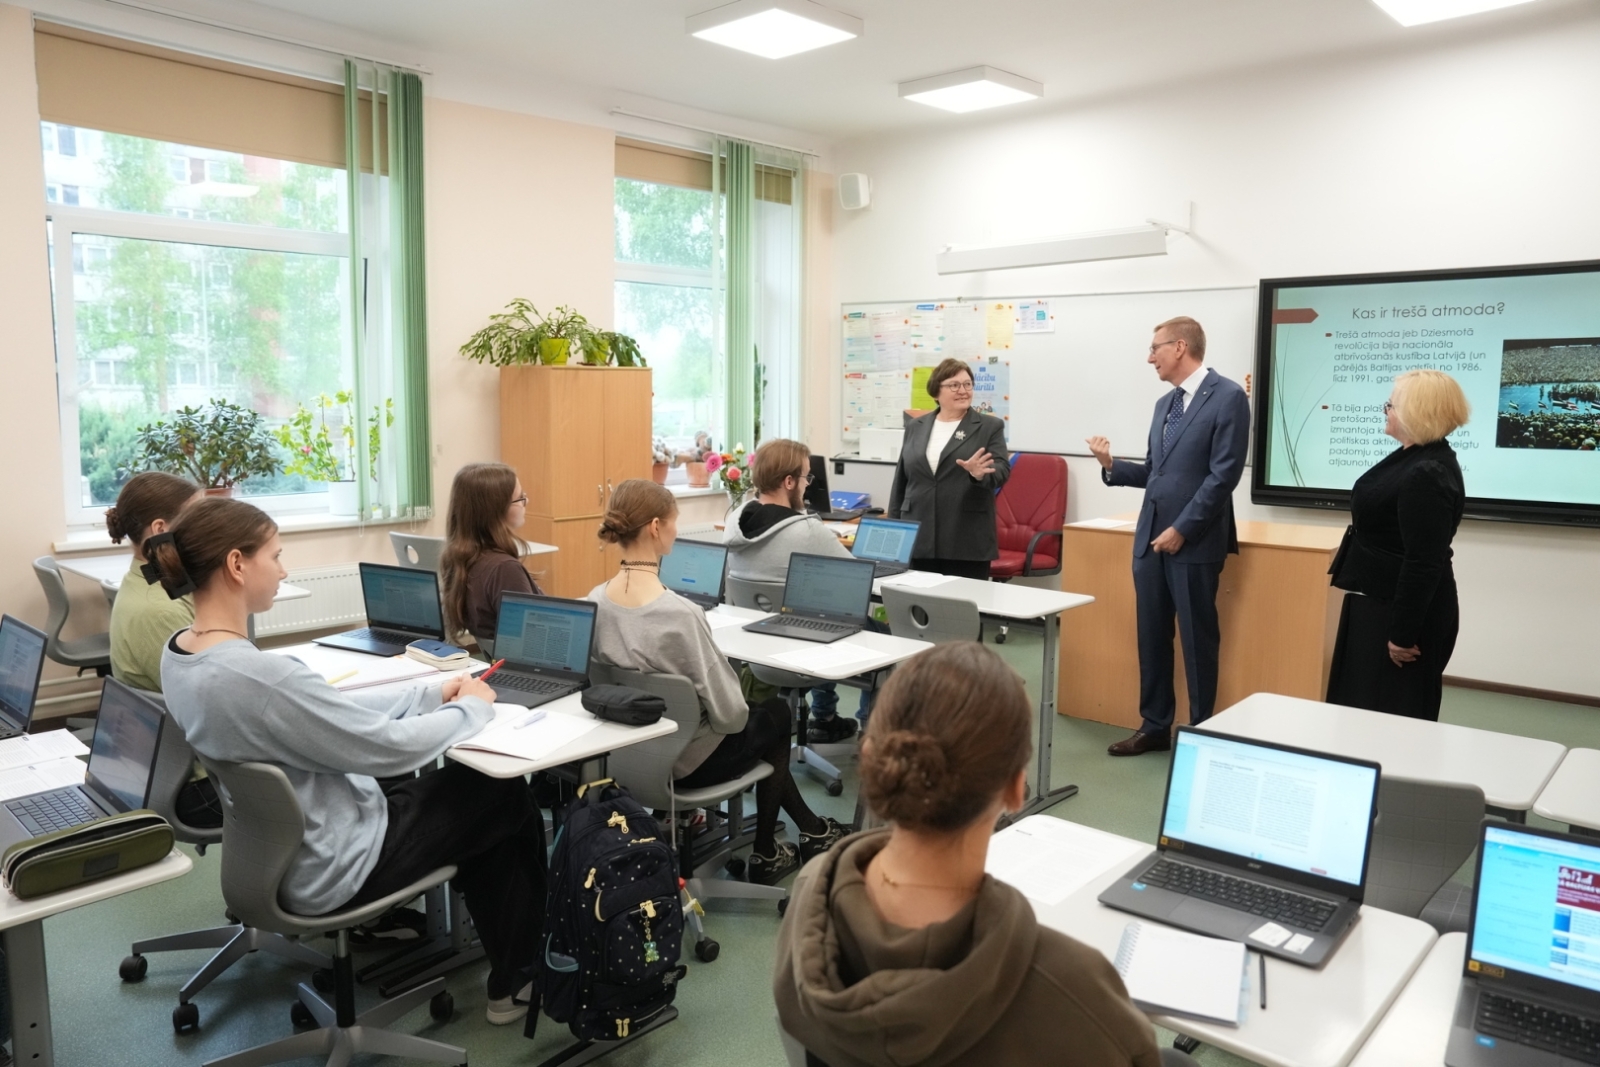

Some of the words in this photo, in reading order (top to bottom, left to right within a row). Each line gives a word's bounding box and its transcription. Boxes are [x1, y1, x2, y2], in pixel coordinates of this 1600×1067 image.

[1352, 307, 1376, 320] Kas
[1380, 306, 1388, 319] ir
[1392, 305, 1427, 318] trešā
[1432, 302, 1505, 317] atmoda?
[1335, 330, 1359, 339] Trešā
[1361, 330, 1400, 338] atmoda
[1402, 329, 1418, 340] jeb
[1420, 328, 1474, 337] Dziesmotā
[1334, 341, 1380, 351] revolūcija
[1382, 341, 1400, 351] bija
[1402, 340, 1453, 349] nacionāla
[1334, 352, 1394, 361] atbrīvošanās
[1395, 351, 1430, 360] kustība
[1432, 350, 1466, 362] Latvijā
[1469, 350, 1486, 362] (un
[1333, 362, 1368, 373] pārējās
[1370, 363, 1402, 373] Baltijas
[1456, 363, 1482, 372] 1986.
[1332, 374, 1347, 383] līdz
[1350, 374, 1374, 383] 1991.
[1331, 404, 1342, 412] Tā
[1344, 404, 1361, 414] bija
[1331, 415, 1382, 424] pretošanās
[1330, 426, 1375, 435] izmantoja
[1329, 437, 1369, 447] politiskas
[1329, 447, 1371, 457] padomju
[1328, 458, 1373, 468] atjaunotu
